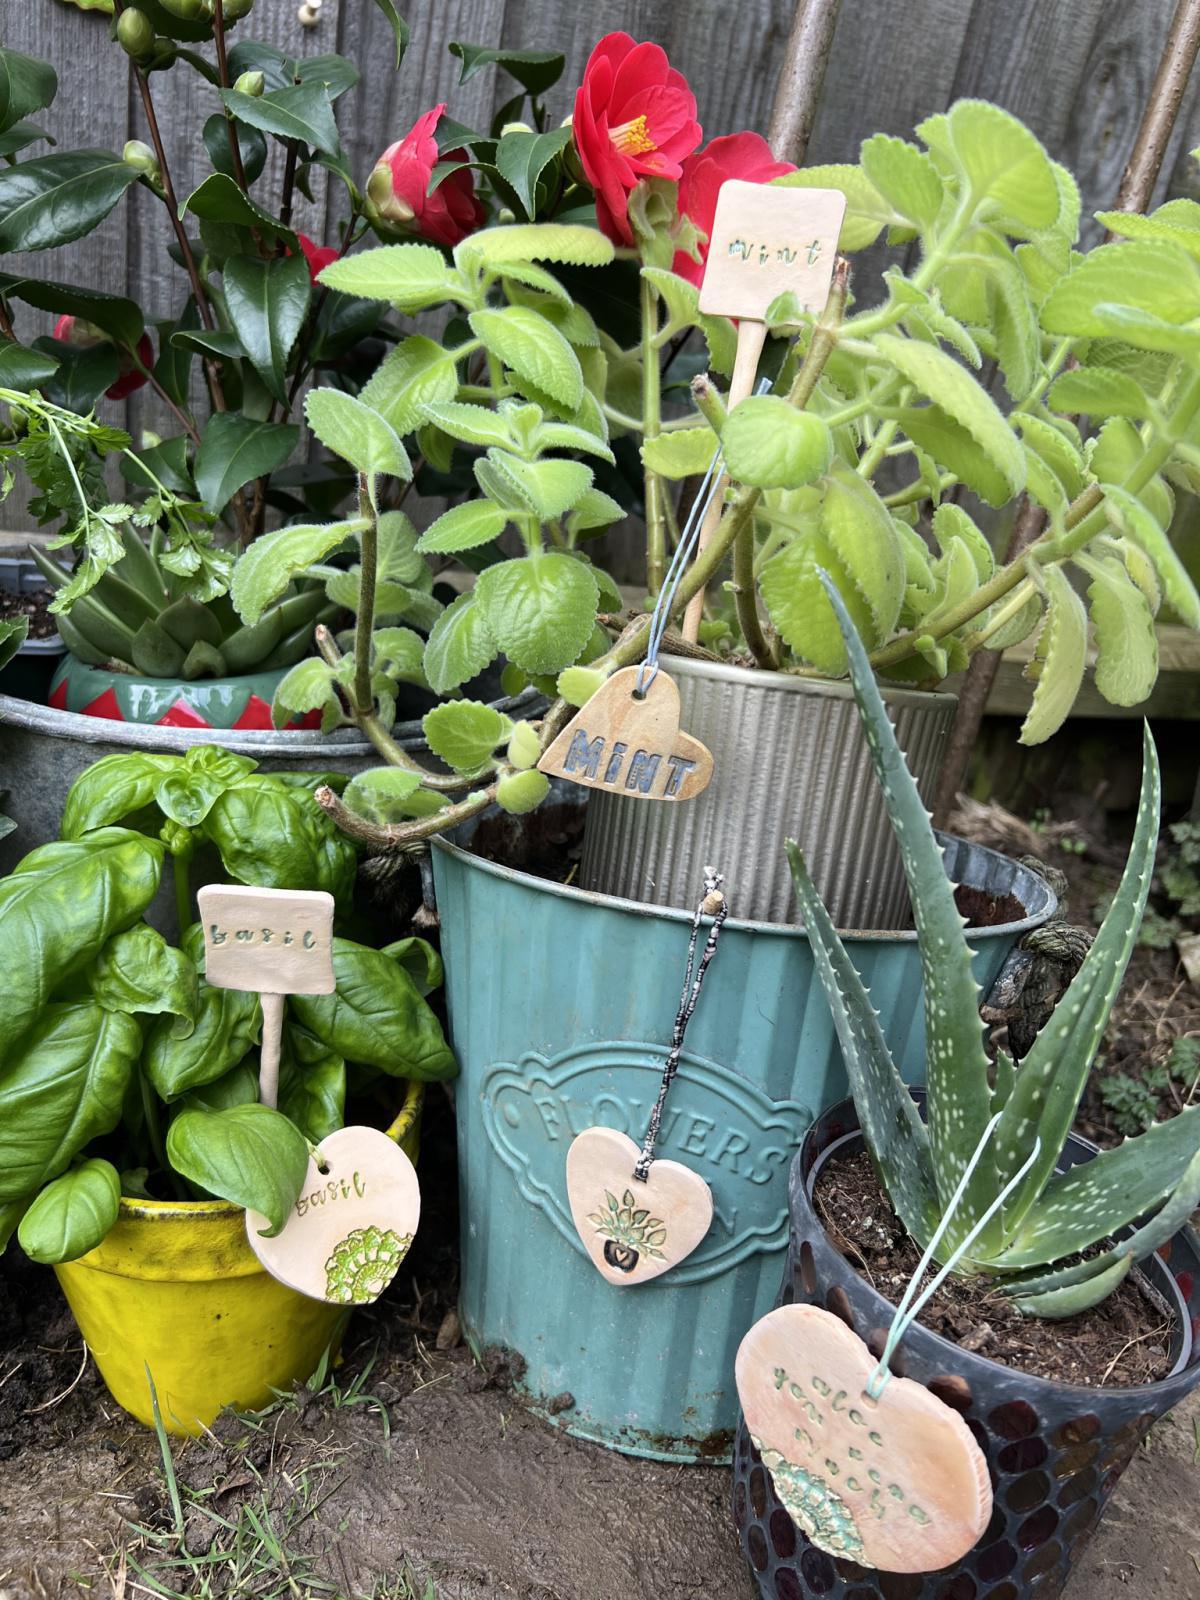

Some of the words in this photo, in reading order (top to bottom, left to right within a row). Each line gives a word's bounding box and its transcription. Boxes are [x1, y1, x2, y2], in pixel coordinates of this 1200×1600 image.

[728, 239, 821, 265] mint
[210, 924, 316, 949] basil
[534, 1093, 788, 1185] FLOWERS
[811, 1375, 883, 1447] aloe
